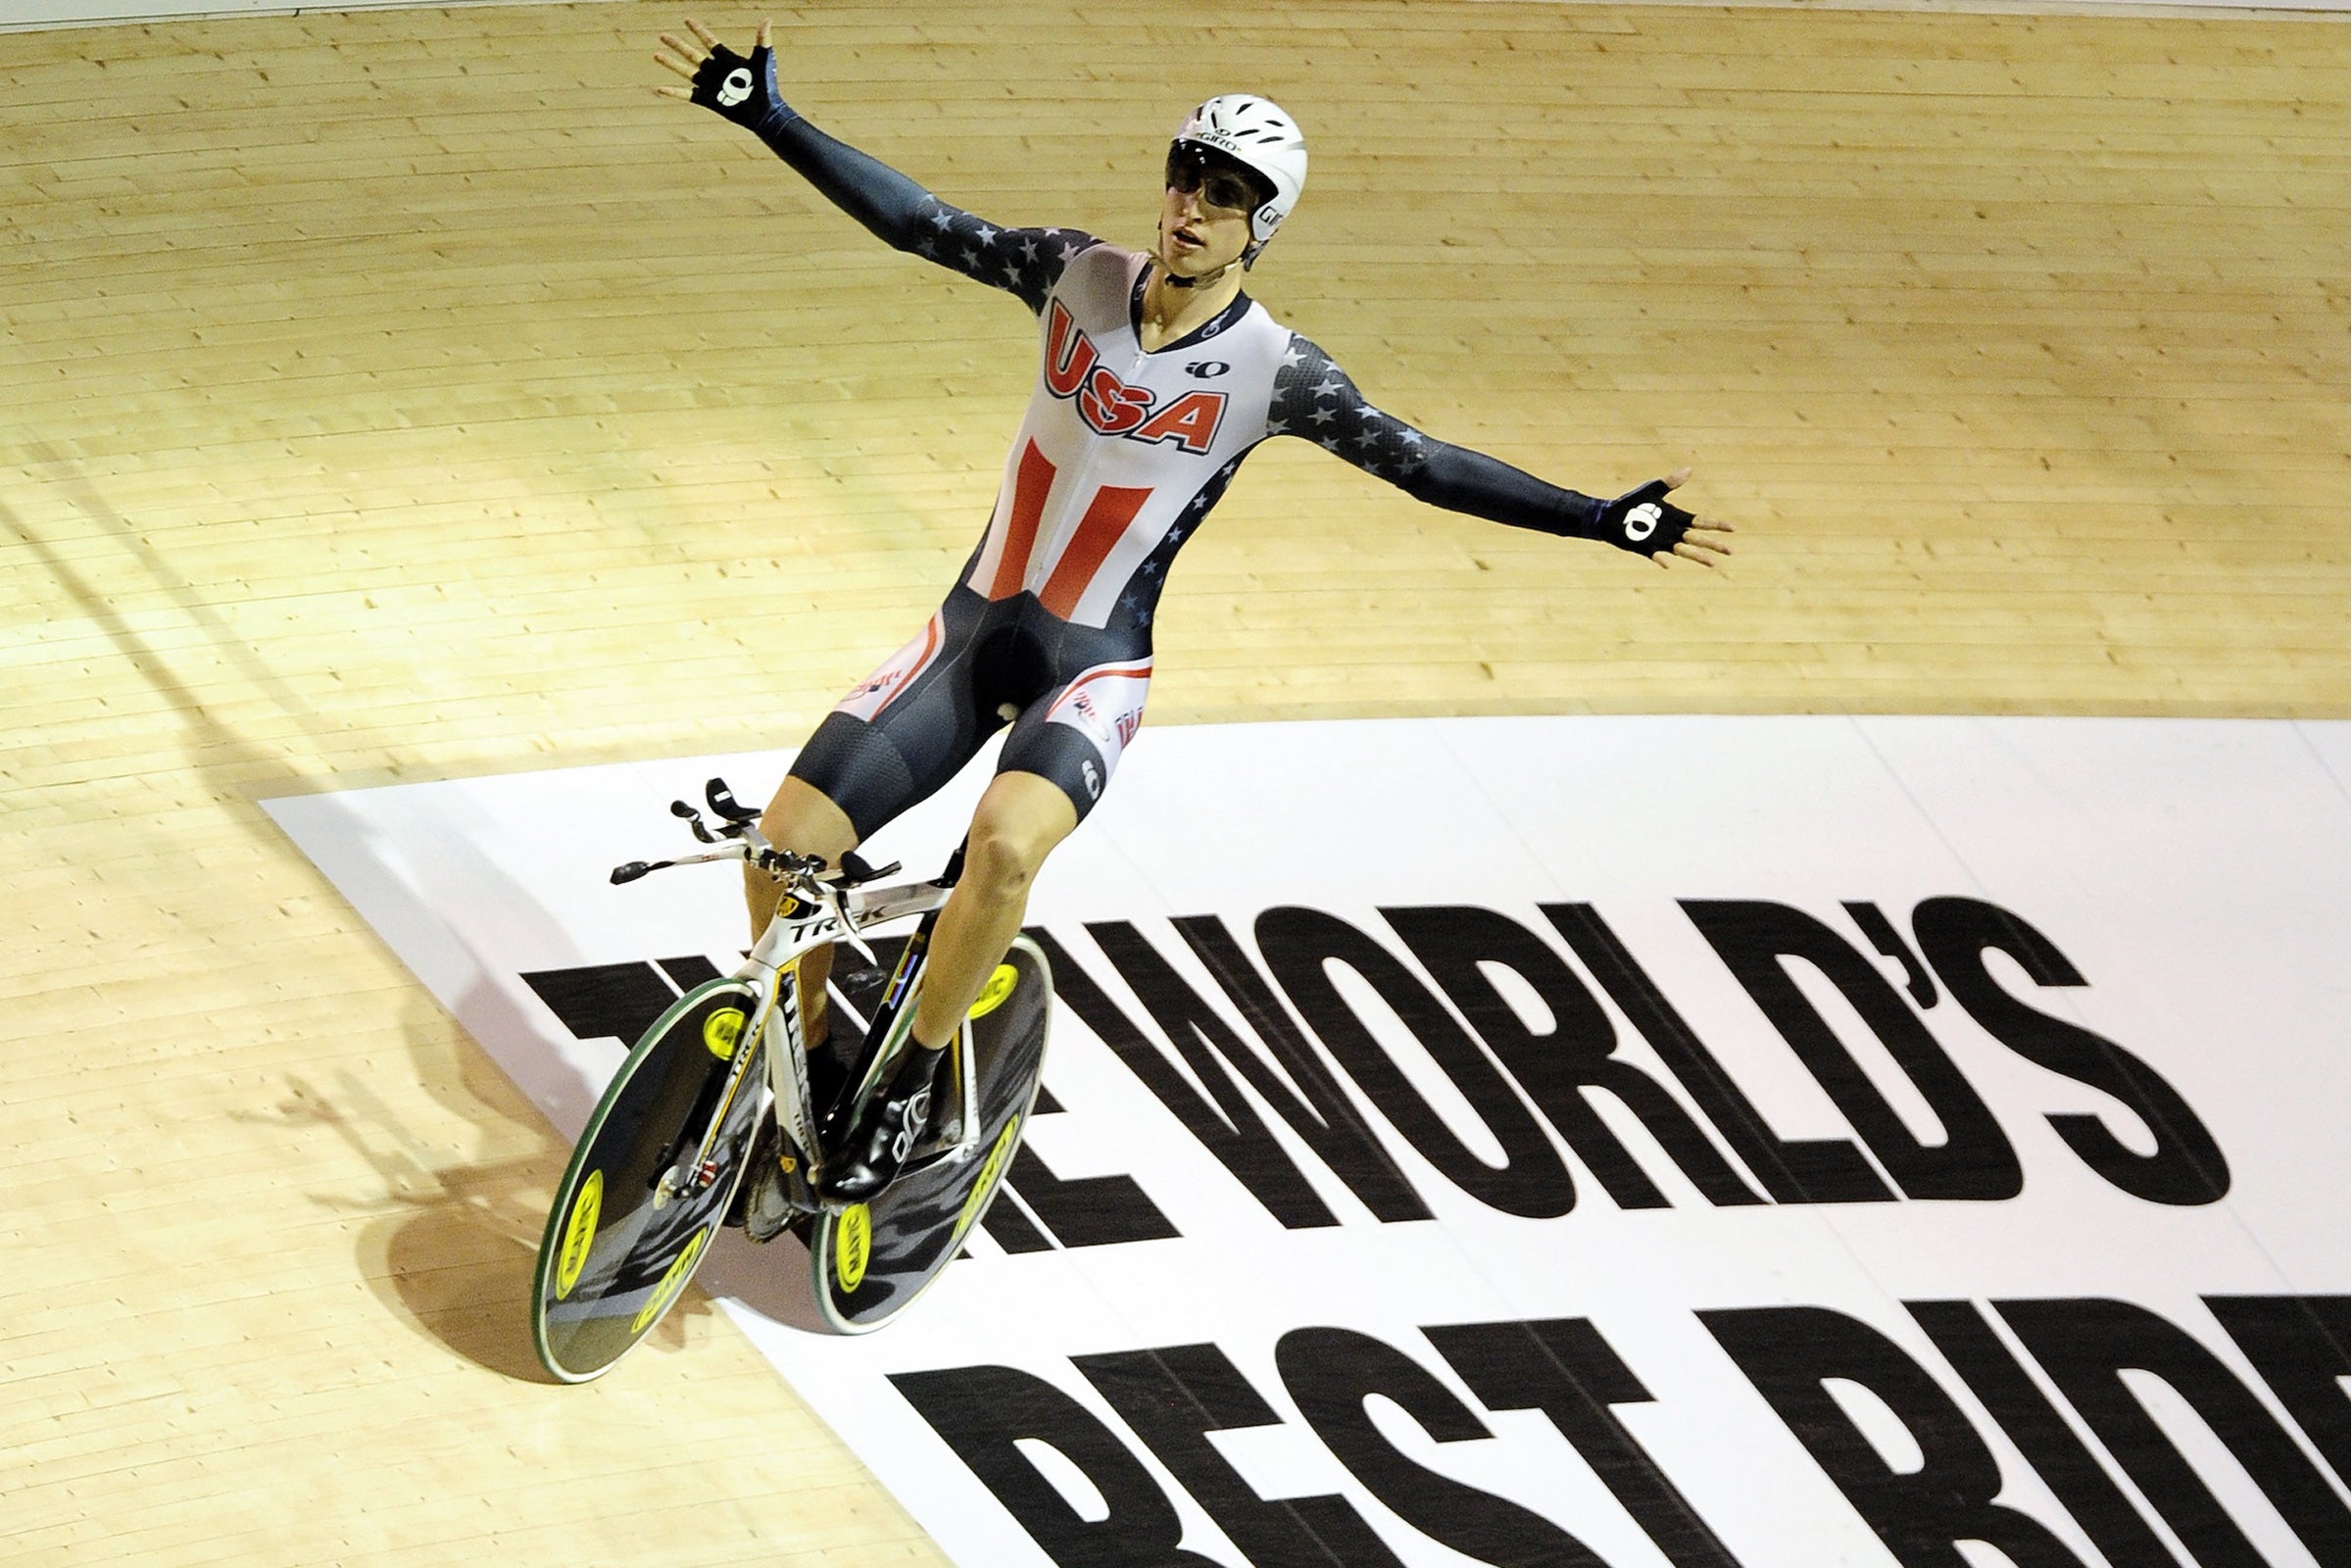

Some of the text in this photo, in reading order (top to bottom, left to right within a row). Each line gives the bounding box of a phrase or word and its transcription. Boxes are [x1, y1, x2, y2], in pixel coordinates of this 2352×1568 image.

[1199, 131, 1238, 151] GIRO
[1044, 296, 1229, 457] USA
[1019, 896, 2231, 1231] WORLD'S
[885, 1317, 1746, 1568] BEST
